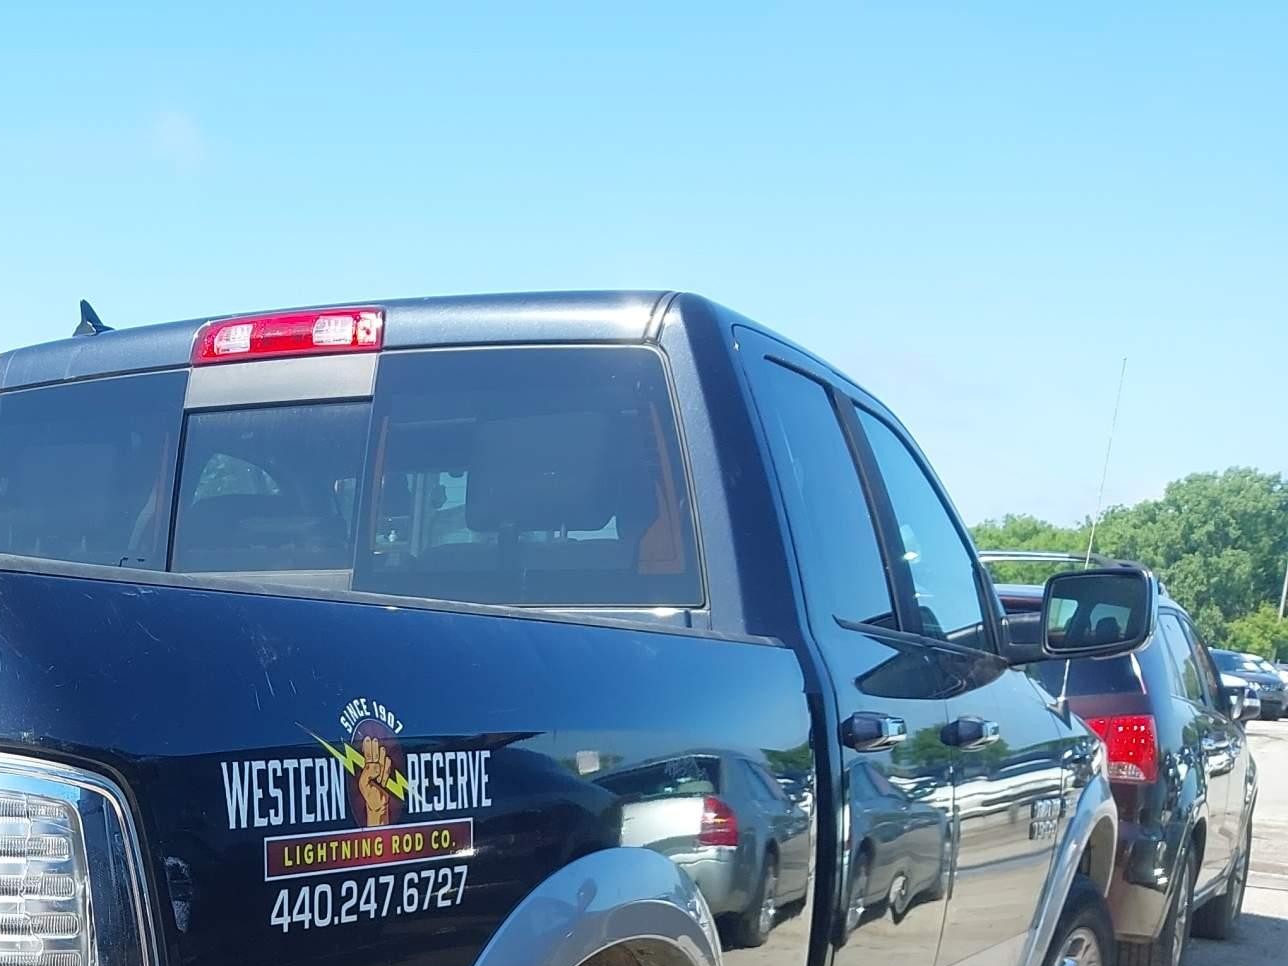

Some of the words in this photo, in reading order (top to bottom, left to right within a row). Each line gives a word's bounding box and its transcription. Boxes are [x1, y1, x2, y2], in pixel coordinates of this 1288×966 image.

[340, 698, 370, 734] SINCE
[372, 700, 404, 734] 1907
[220, 757, 347, 830] WESTERN
[406, 750, 492, 814] RESERVE
[283, 840, 384, 868] LIGHTNING
[391, 833, 425, 853] ROD
[431, 829, 456, 850] CO.
[270, 865, 468, 933] 440.247.6727
